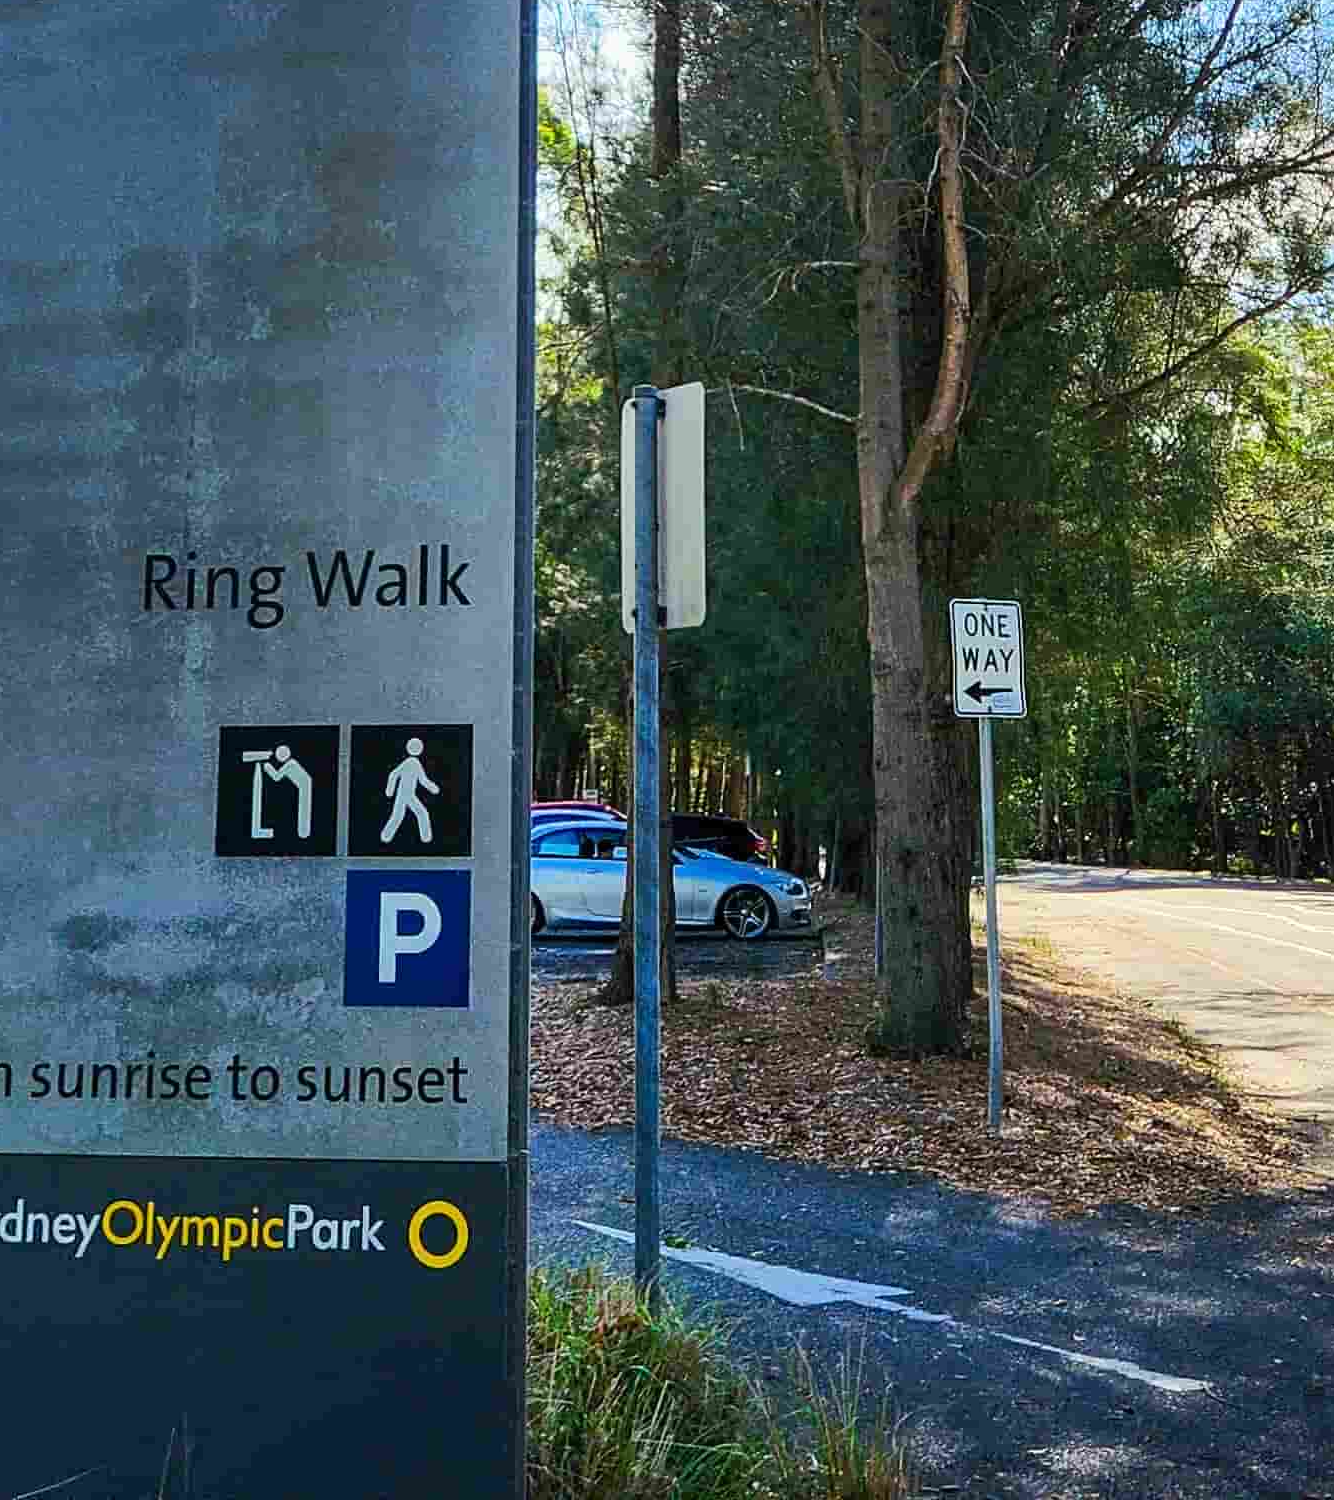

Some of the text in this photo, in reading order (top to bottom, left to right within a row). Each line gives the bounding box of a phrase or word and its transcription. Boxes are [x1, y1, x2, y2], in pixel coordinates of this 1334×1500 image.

[142, 544, 472, 630] Ring Walk
[964, 612, 1012, 638] ONE
[962, 647, 1014, 673] WAY
[378, 891, 443, 984] P
[30, 1052, 212, 1102] sunrise
[227, 1057, 279, 1102] to
[297, 1056, 468, 1104] sunset
